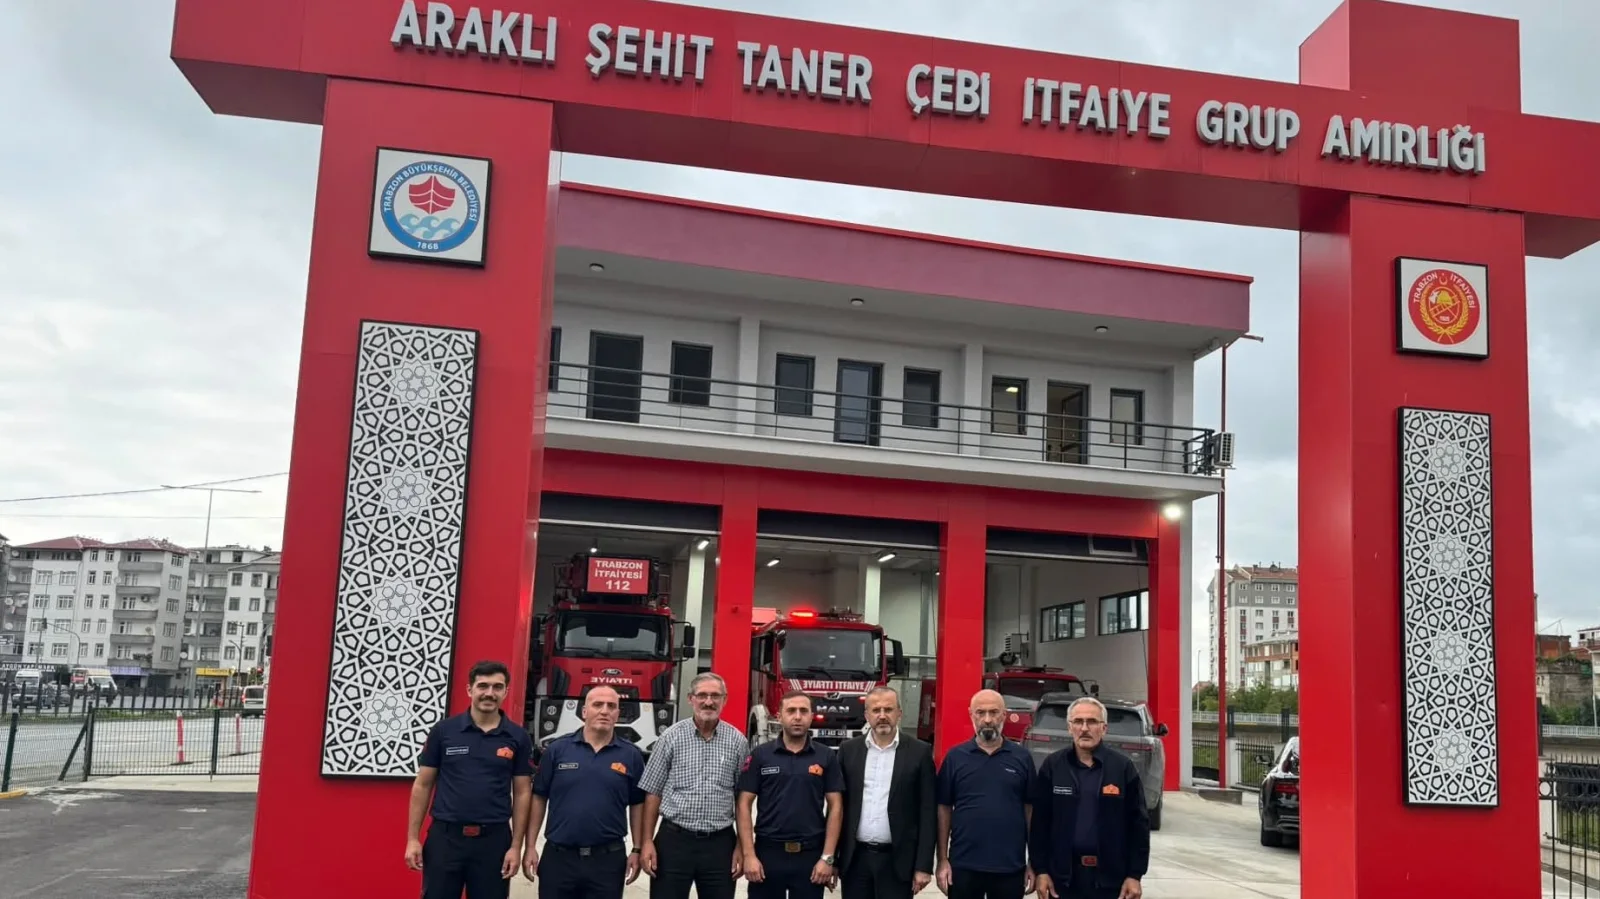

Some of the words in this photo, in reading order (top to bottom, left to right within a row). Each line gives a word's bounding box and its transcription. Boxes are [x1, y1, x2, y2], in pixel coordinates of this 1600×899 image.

[391, 0, 557, 64] ARAKLI
[585, 22, 714, 83] ŞEHİT
[737, 41, 873, 101] TANER
[906, 63, 990, 117] ÇEBİ
[1023, 77, 1171, 138] İTFAİYE
[1197, 100, 1300, 152] GRUP
[1321, 114, 1486, 174] AMİRLİĞİ
[384, 175, 404, 212] TRABZON
[402, 163, 459, 180] BÜYÜKŞEHİR
[417, 241, 439, 250] 1868
[1413, 272, 1438, 303] TRABZON
[595, 560, 643, 570] TRABZON
[594, 568, 643, 579] İTFAİYESİ
[605, 580, 630, 591] 112
[816, 705, 850, 713] MAN
